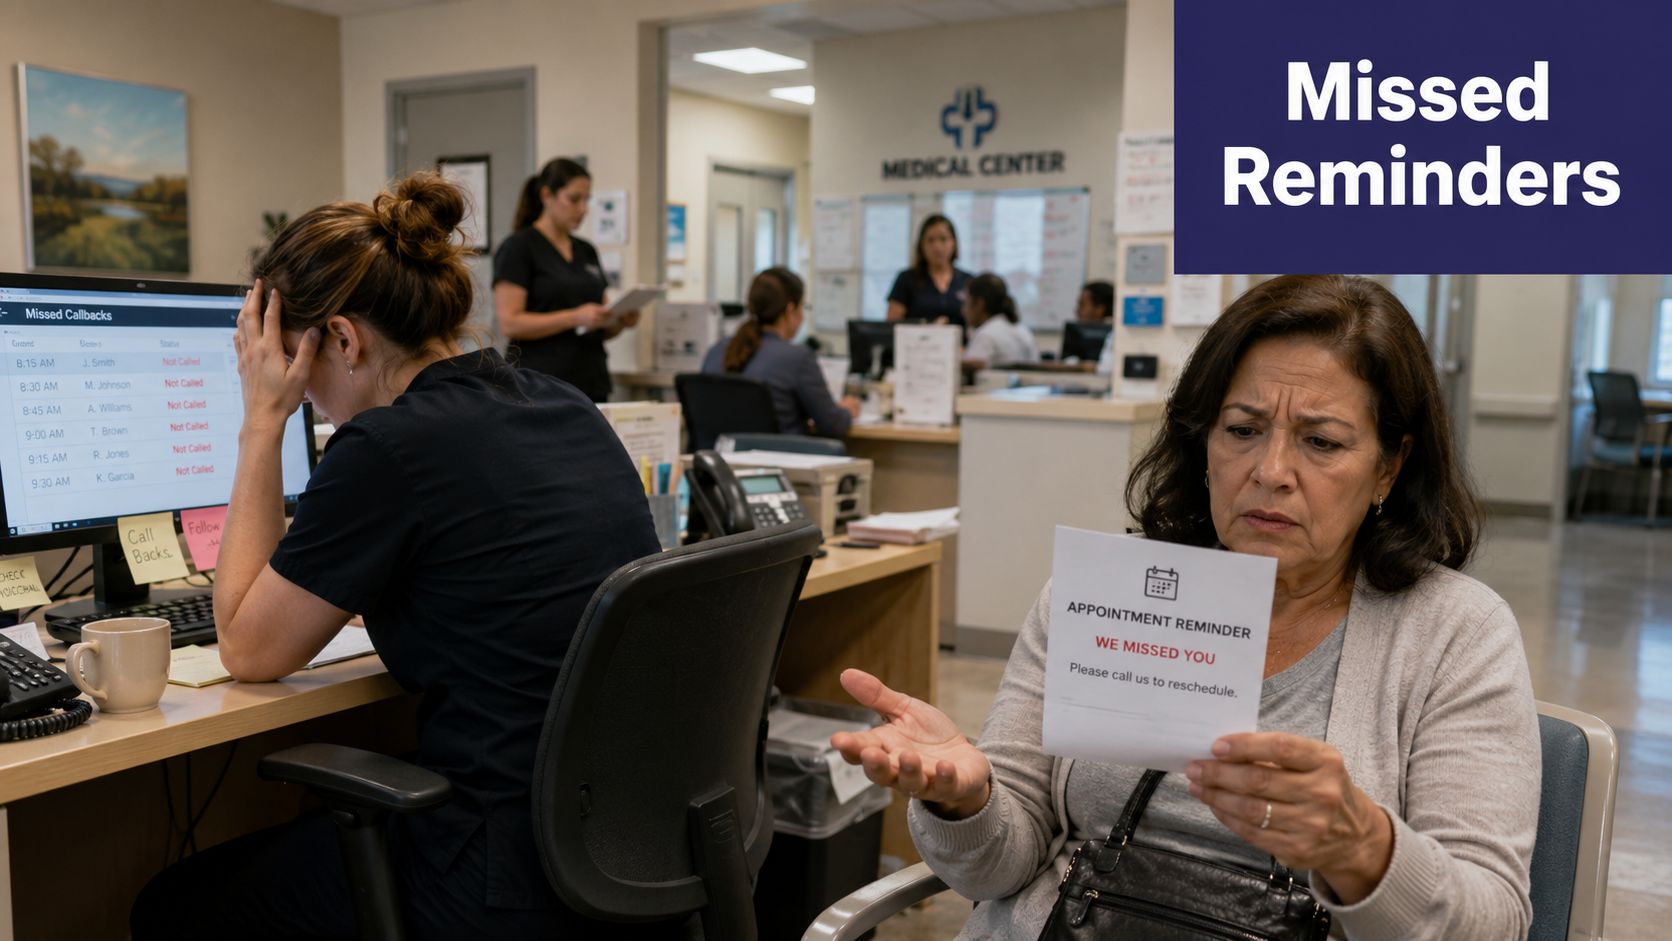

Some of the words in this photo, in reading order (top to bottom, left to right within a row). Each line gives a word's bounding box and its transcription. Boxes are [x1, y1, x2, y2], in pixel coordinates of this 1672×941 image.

[881, 155, 973, 180] MEDICAL
[978, 151, 1066, 177] CENTER
[25, 308, 63, 320] Missed
[65, 309, 112, 321] Callbacks
[16, 358, 37, 369] 8:15
[40, 358, 55, 368] AM
[93, 358, 116, 368] Smith
[163, 357, 176, 367] Not
[178, 357, 201, 366] Called
[19, 382, 41, 392] 8:30
[43, 381, 59, 391] AM
[98, 380, 131, 391] Johnson
[164, 379, 179, 389] Not
[180, 378, 204, 388] Called
[22, 405, 44, 416] 8:45
[46, 405, 62, 415] AM
[99, 402, 133, 413] Williams
[167, 401, 182, 410] Not
[183, 400, 207, 409] Called
[25, 430, 47, 441] 9:00
[49, 429, 65, 439] AM
[102, 426, 129, 436] Brown
[170, 423, 184, 432] Not
[185, 422, 209, 431] Called
[28, 454, 50, 464] 9:15
[51, 452, 68, 463] AM
[105, 449, 130, 460] Jones
[172, 445, 187, 454] Not
[188, 443, 212, 453] Called
[31, 478, 53, 489] 9:30
[55, 476, 71, 487] AM
[107, 472, 135, 482] Garcia
[176, 467, 190, 476] Not
[191, 465, 215, 475] Called
[127, 528, 154, 545] Call
[187, 521, 220, 535] Follow
[1067, 601, 1172, 627] APPOINTMENT
[1176, 618, 1252, 640] REMINDER
[1096, 636, 1119, 651] WE
[1123, 639, 1179, 660] MISSED
[1184, 649, 1216, 665] YOU
[1070, 662, 1109, 678] Please
[1112, 669, 1133, 683] call
[1135, 675, 1149, 685] us
[1153, 677, 1165, 688] to
[1168, 680, 1238, 698] reschedule.
